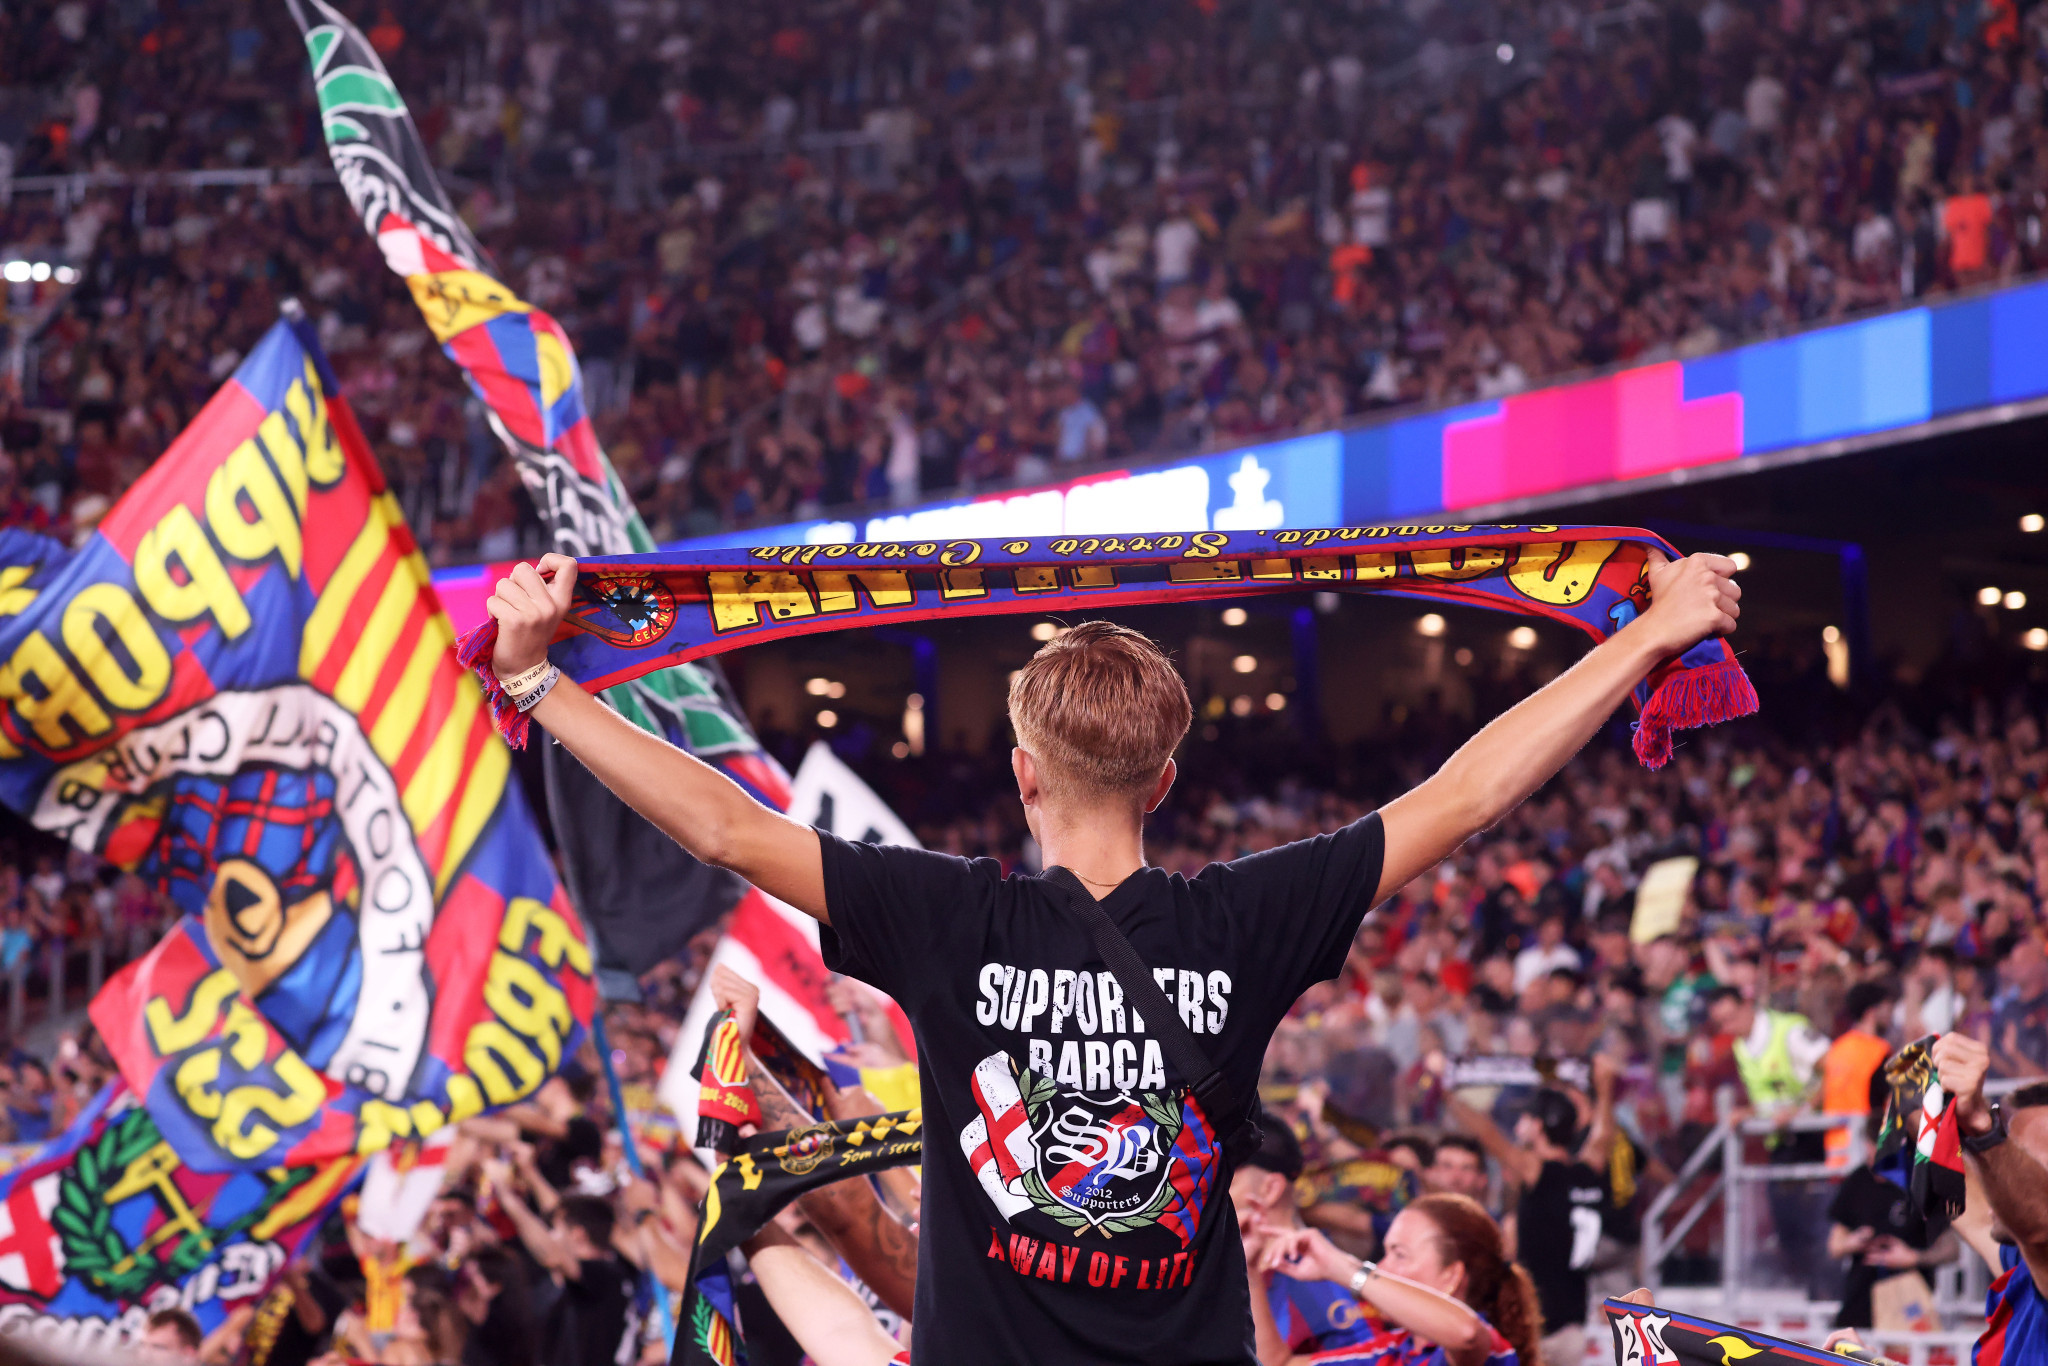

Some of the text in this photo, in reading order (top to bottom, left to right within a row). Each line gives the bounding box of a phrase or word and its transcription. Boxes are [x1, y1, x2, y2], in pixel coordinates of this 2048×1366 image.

[976, 963, 1232, 1036] SUPPORERS
[1029, 1039, 1166, 1097] BARÇA
[839, 1149, 872, 1167] Som
[888, 1140, 922, 1155] sere
[1059, 1185, 1140, 1209] Supporters
[1085, 1187, 1112, 1199] 2012
[1009, 1233, 1080, 1283] WAY
[1088, 1251, 1129, 1288] OF
